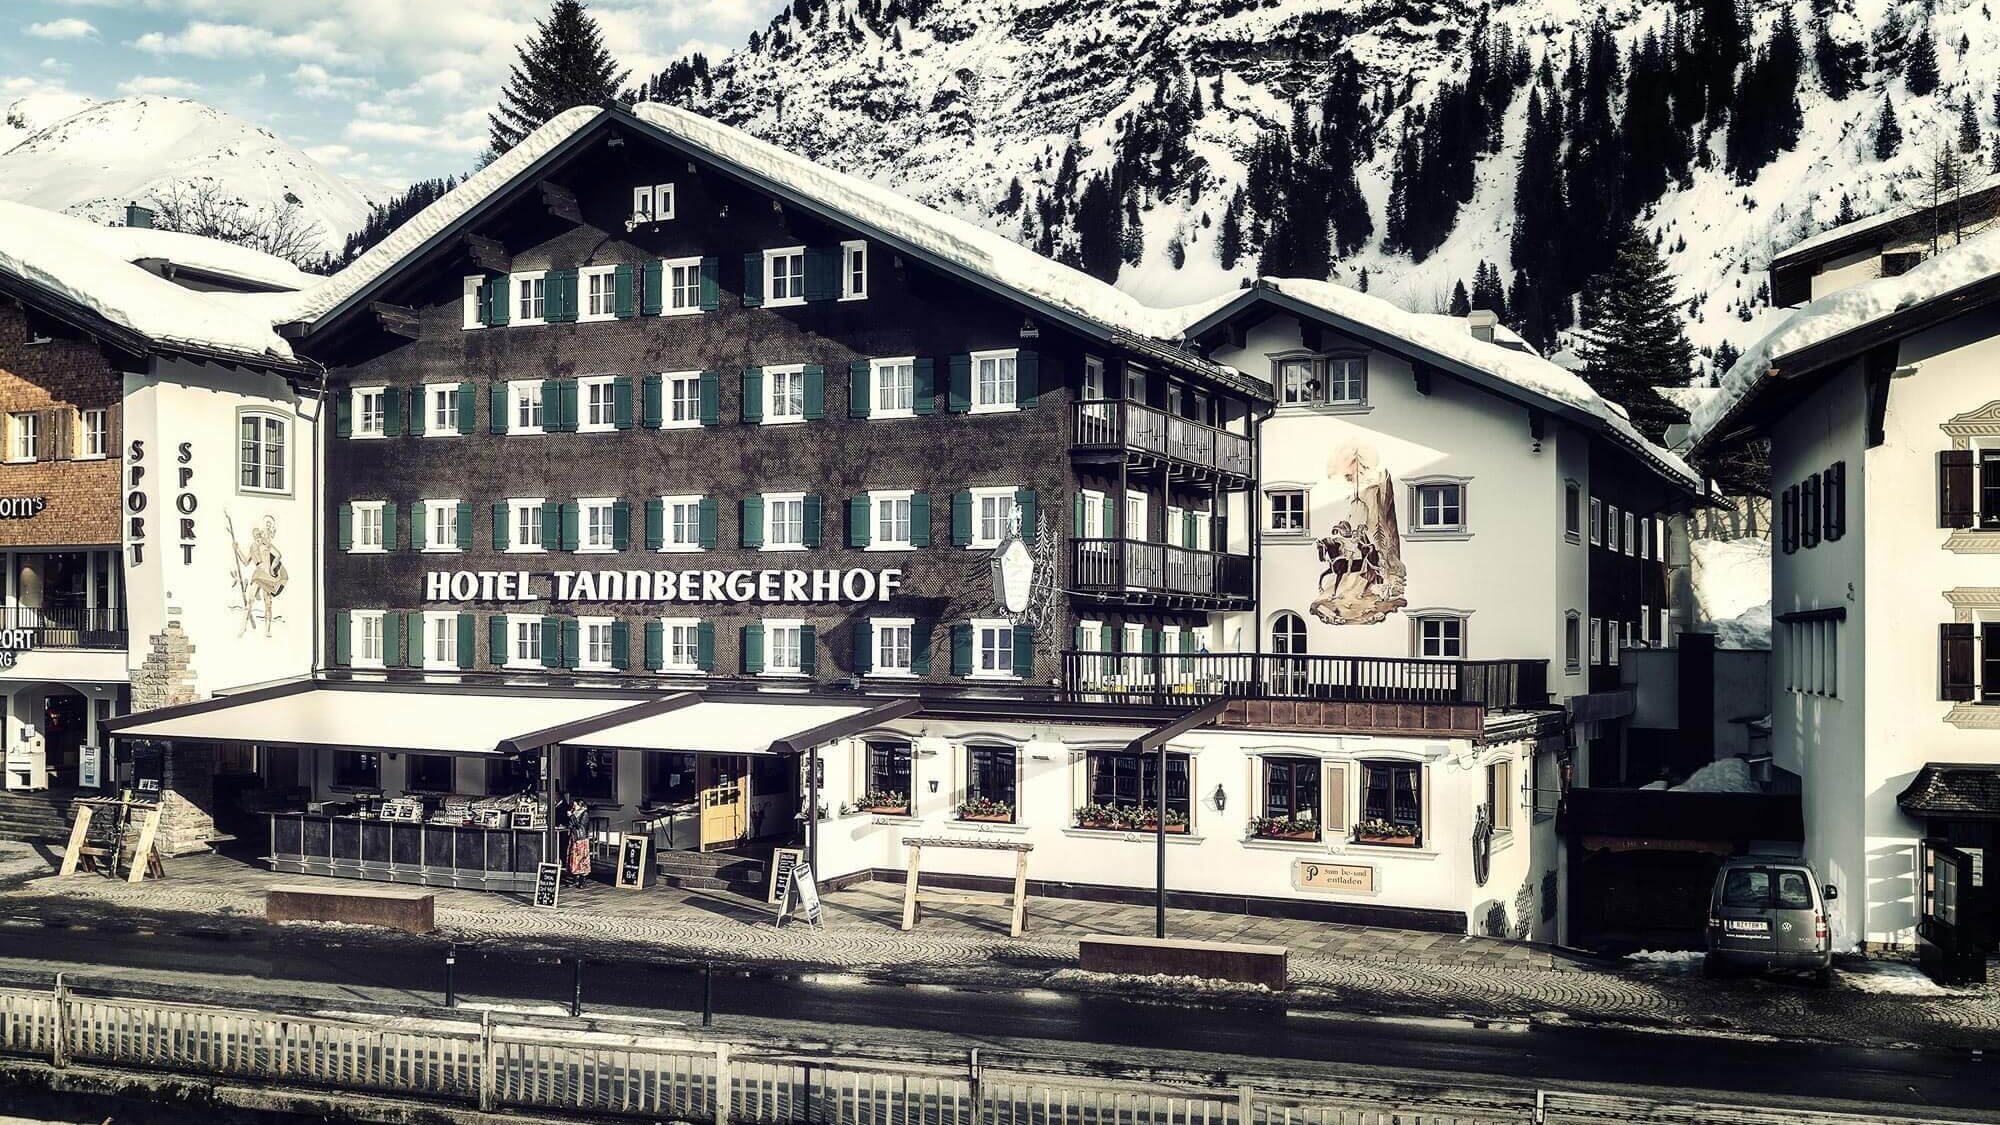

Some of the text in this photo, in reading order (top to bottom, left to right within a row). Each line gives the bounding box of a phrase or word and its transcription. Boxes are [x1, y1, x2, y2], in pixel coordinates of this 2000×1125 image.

[126, 440, 148, 566] SPORT
[176, 442, 197, 565] SPORT
[426, 570, 538, 601] HOTEL
[0, 629, 34, 649] ORT
[1306, 865, 1319, 881] P
